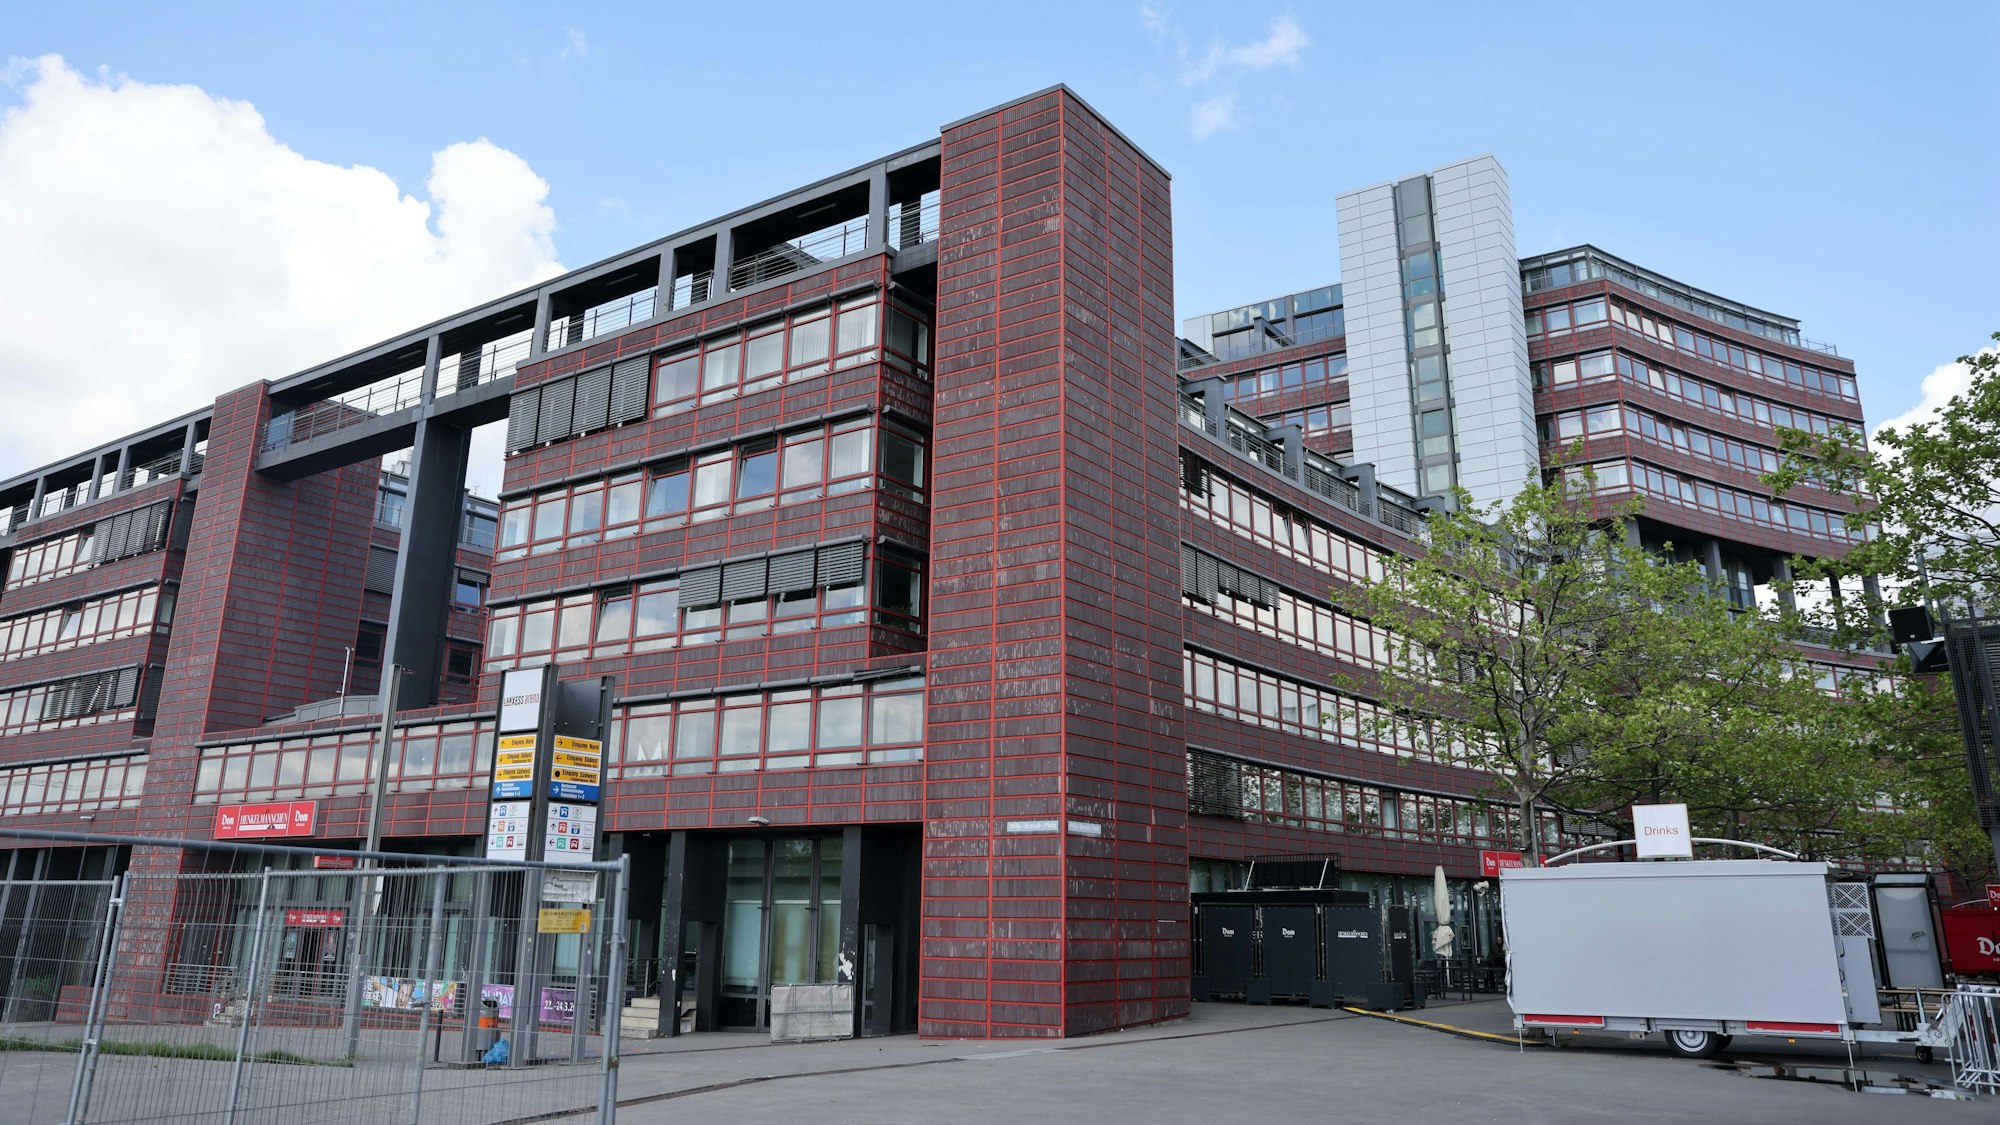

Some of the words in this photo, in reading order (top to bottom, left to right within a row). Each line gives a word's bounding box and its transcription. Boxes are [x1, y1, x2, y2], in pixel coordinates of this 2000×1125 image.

[572, 741, 588, 749] Eingang
[221, 814, 234, 825] Dom
[294, 810, 309, 822] Dom
[1644, 826, 1679, 836] Drinks
[1222, 927, 1235, 935] Dom
[1282, 927, 1296, 936] Dom
